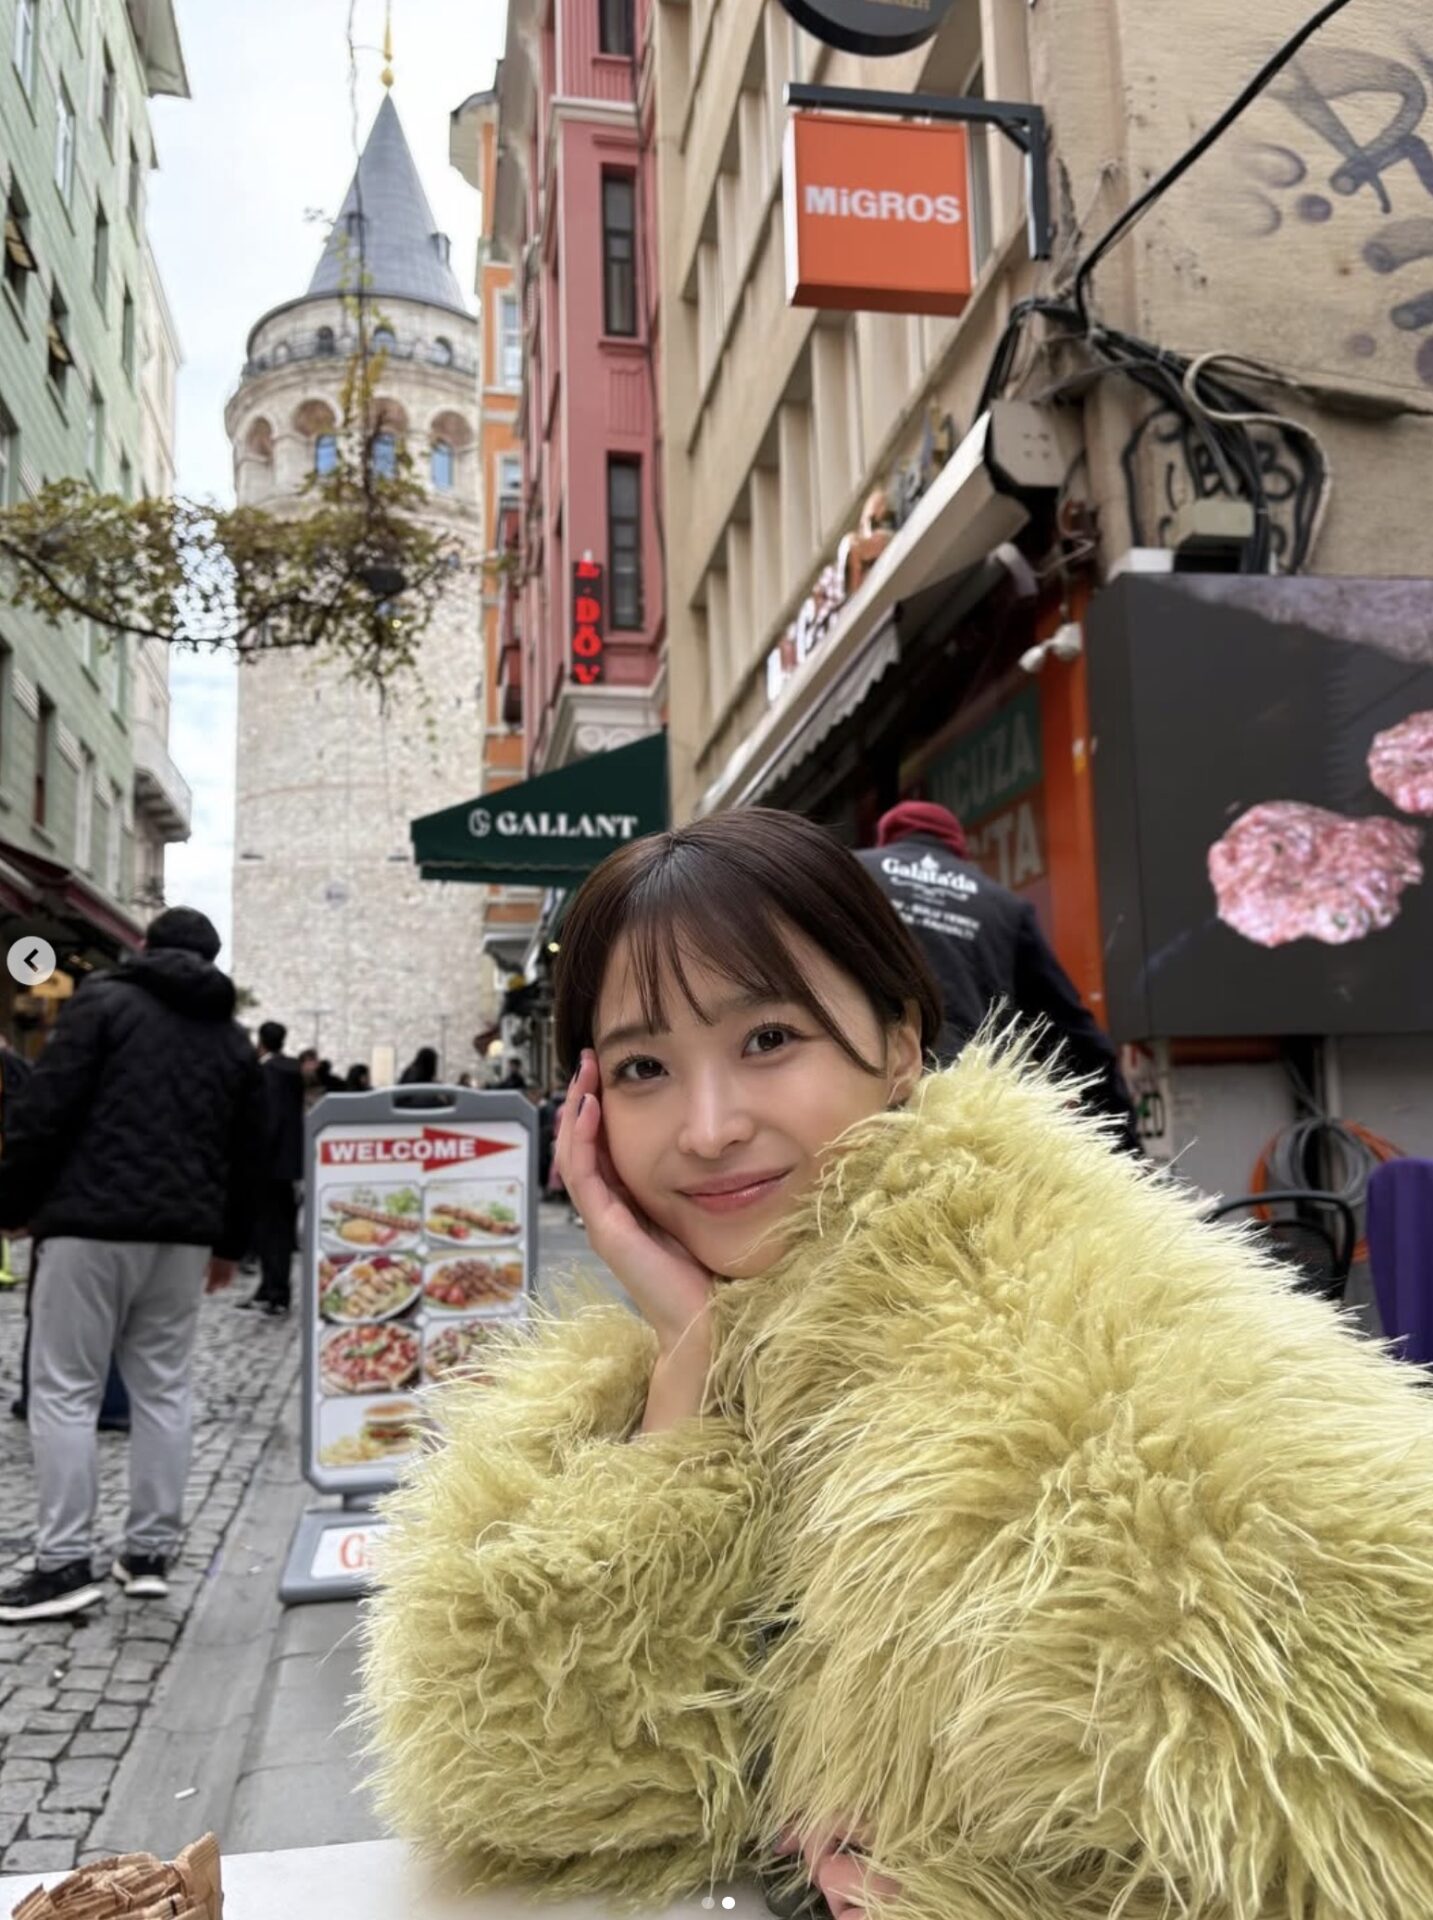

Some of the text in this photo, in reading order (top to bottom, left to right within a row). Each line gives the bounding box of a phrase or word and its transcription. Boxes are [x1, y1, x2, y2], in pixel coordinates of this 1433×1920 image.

[804, 185, 961, 224] MiGROS
[495, 810, 639, 839] GALLANT
[328, 1138, 477, 1162] WELCOME
